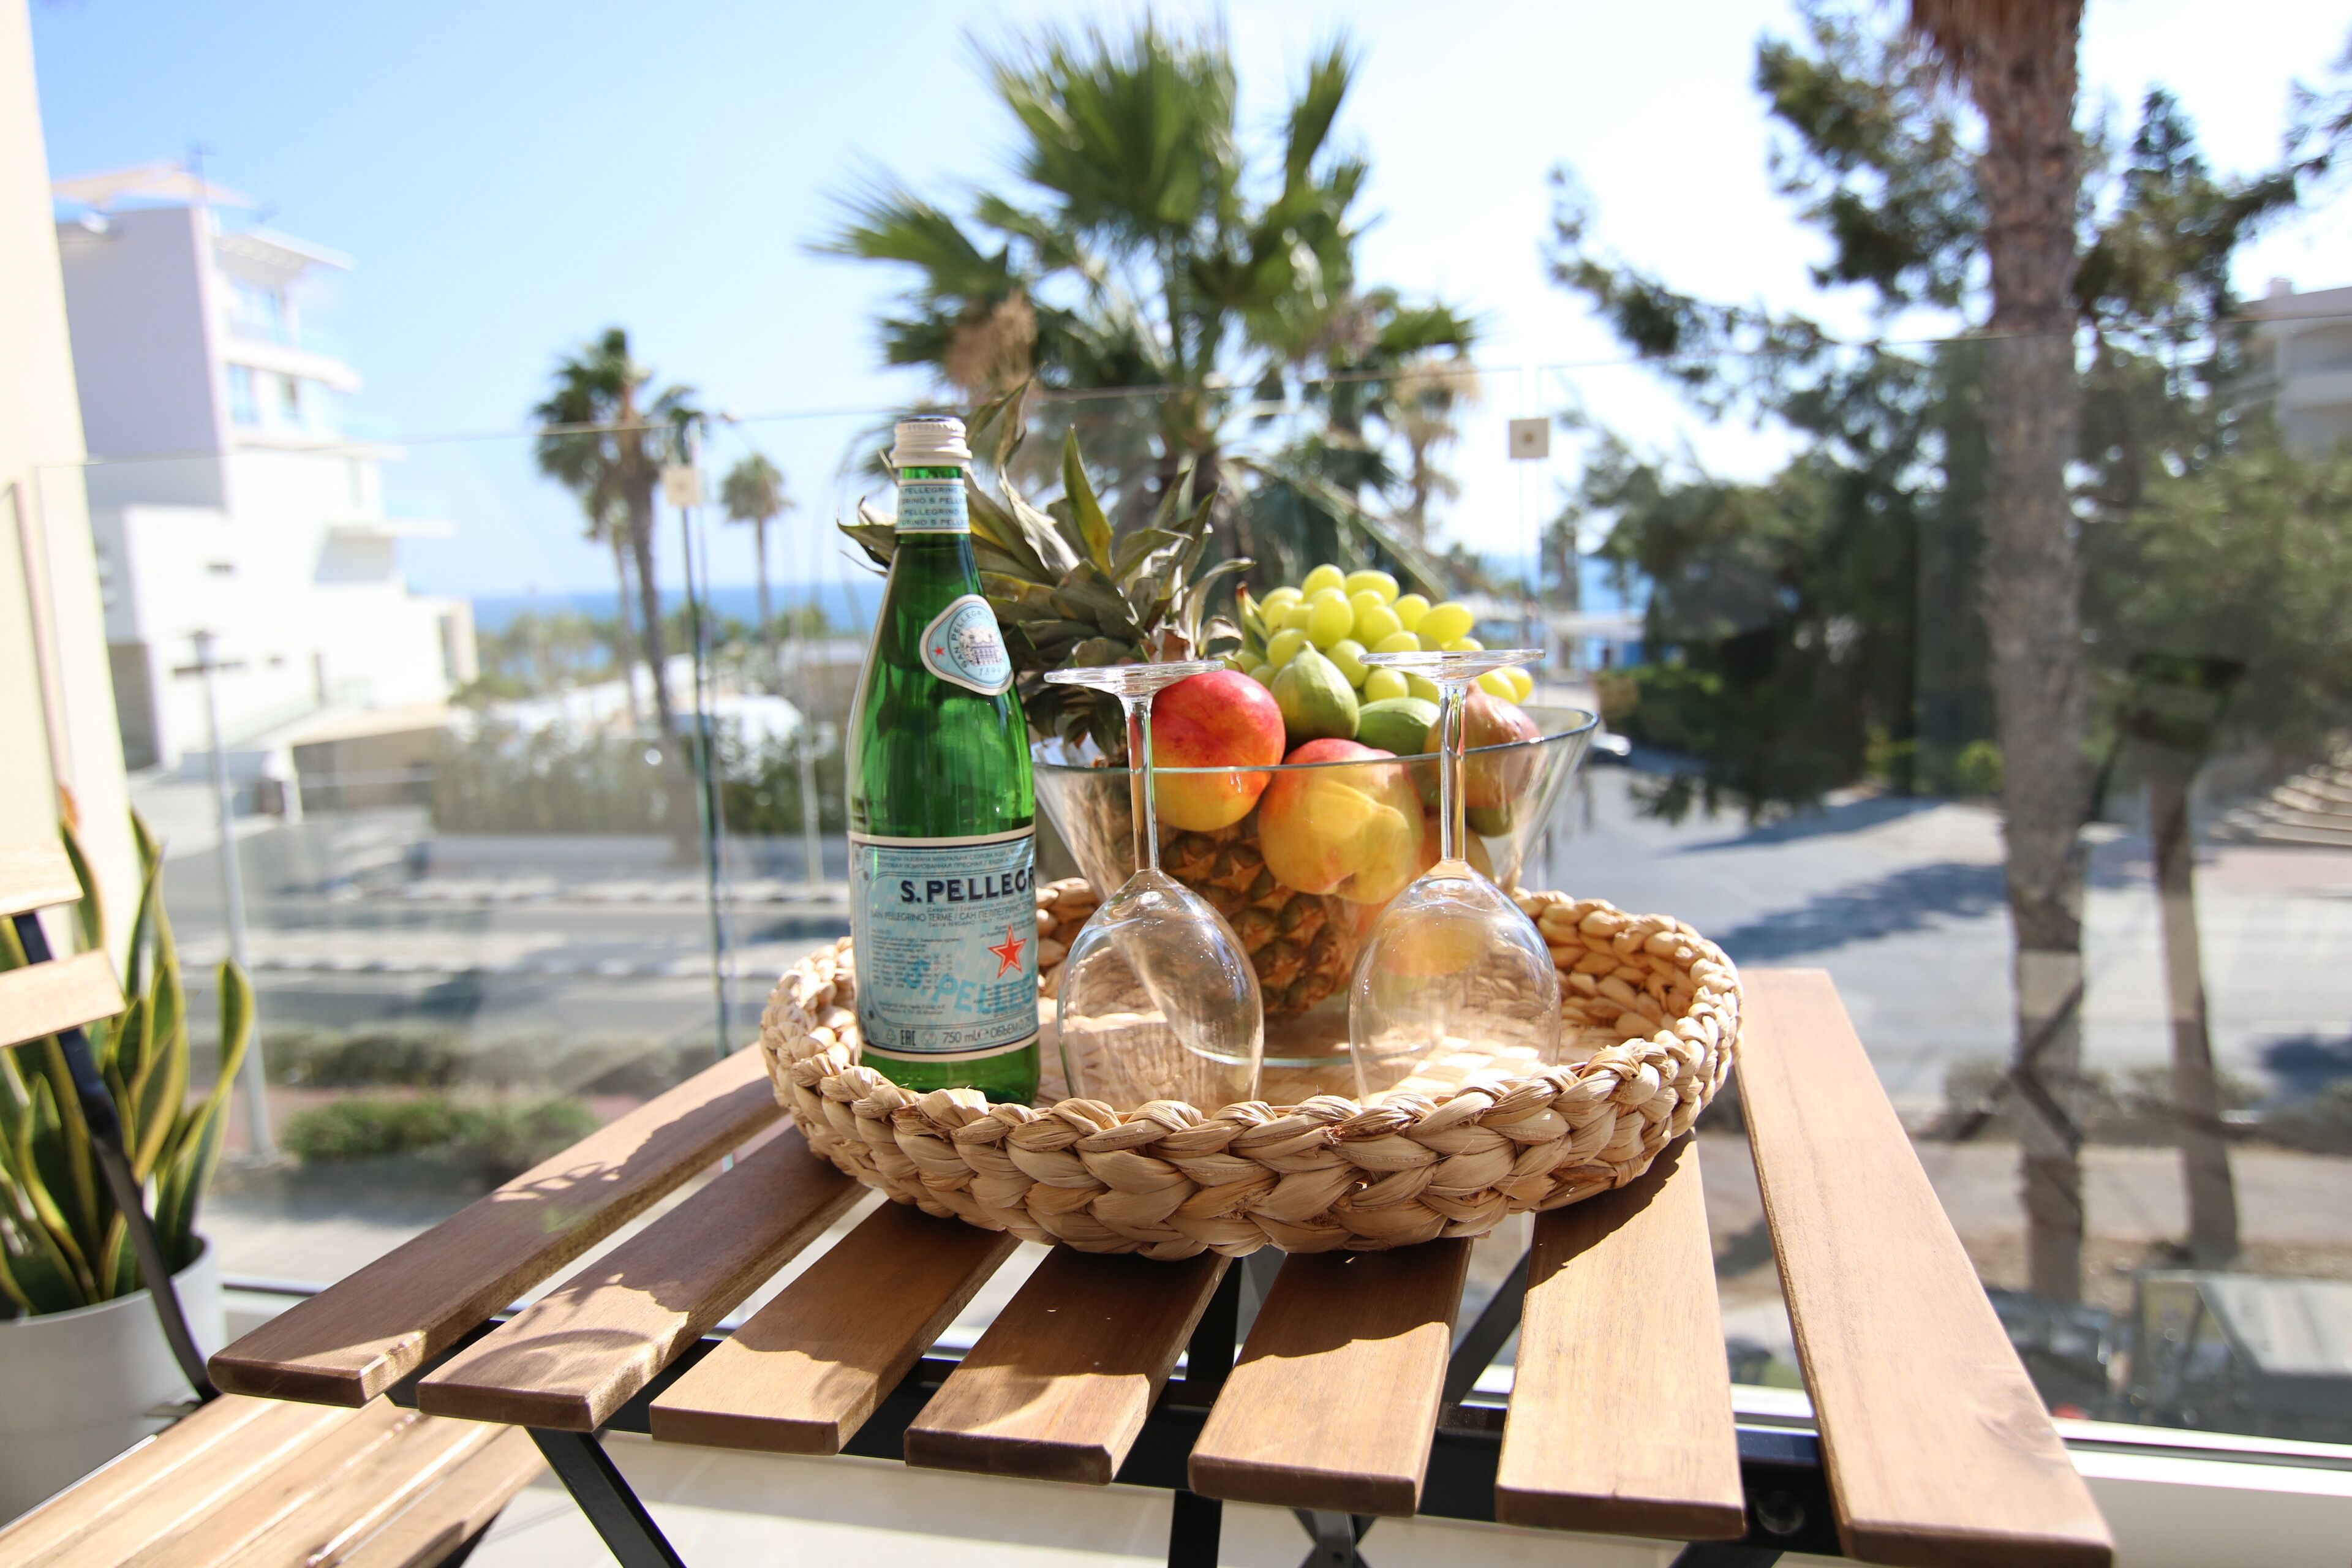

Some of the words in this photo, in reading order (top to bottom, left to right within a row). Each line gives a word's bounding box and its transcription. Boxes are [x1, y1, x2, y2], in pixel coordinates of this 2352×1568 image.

[954, 647, 968, 668] SAN
[885, 911, 926, 922] PELLEGRINO
[928, 913, 952, 921] TERME
[942, 1031, 962, 1044] 750
